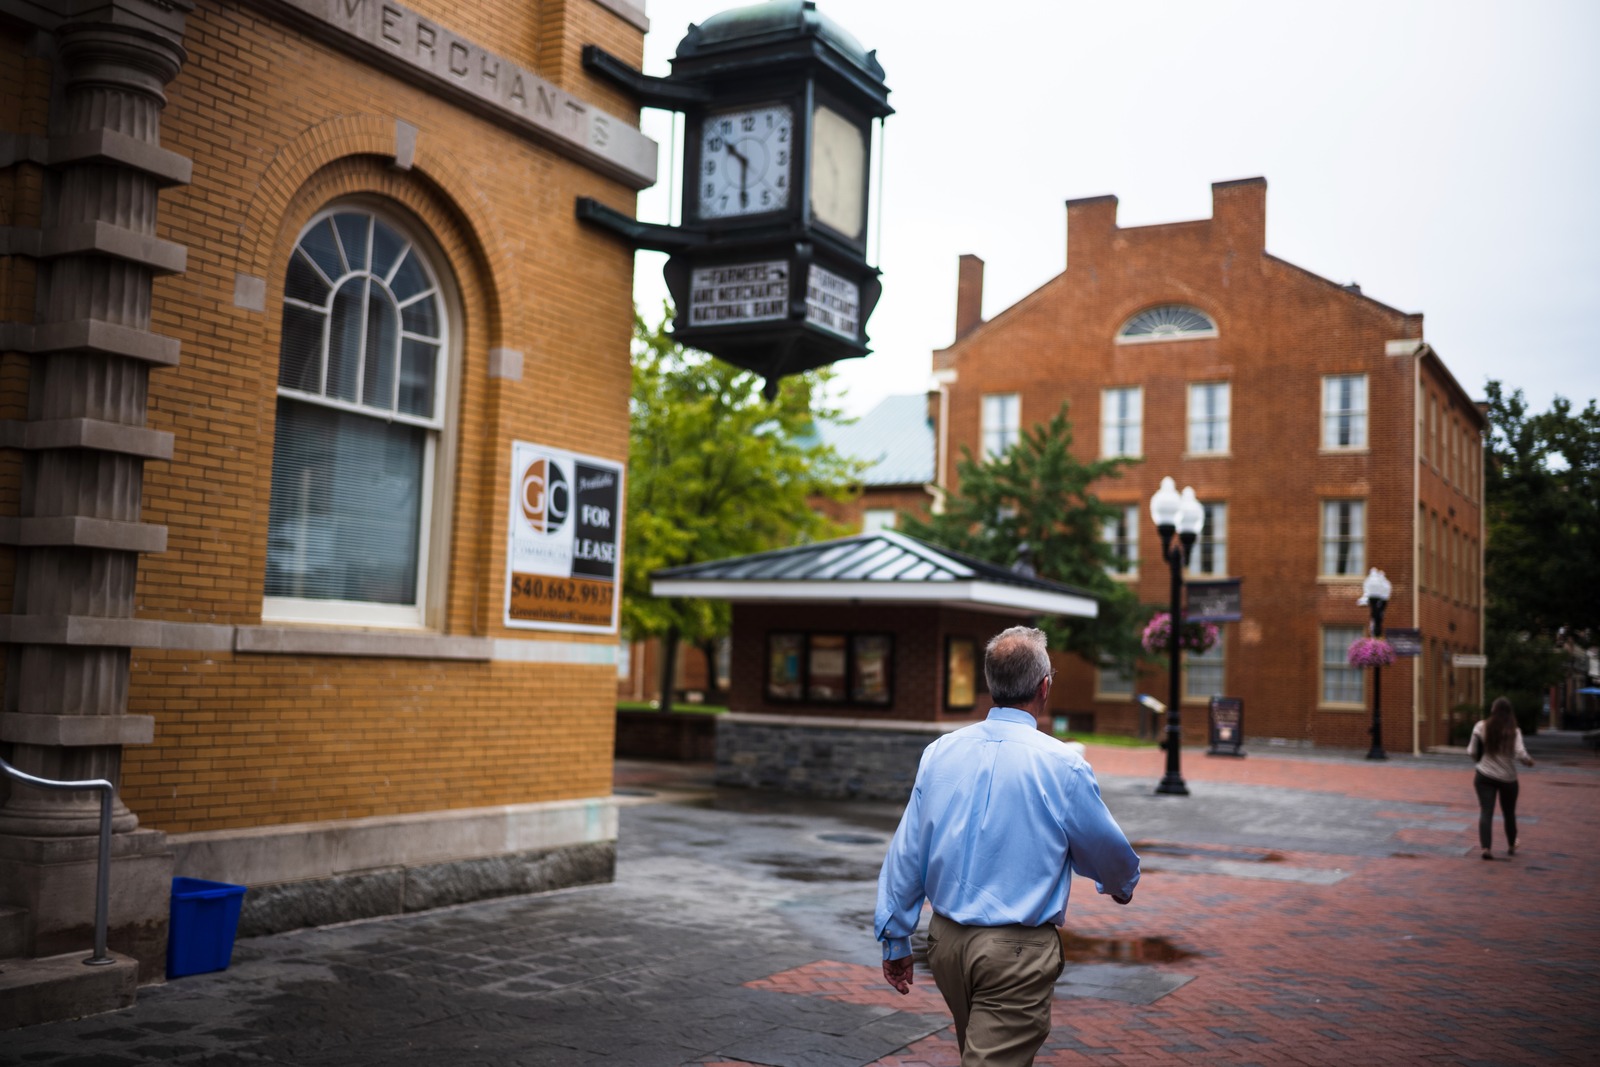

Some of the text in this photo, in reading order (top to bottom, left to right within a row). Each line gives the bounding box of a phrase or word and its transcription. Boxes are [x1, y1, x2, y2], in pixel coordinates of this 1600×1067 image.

[741, 116, 756, 132] 12
[778, 127, 788, 142] 2
[581, 504, 610, 528] FOR
[575, 538, 615, 564] LEASE
